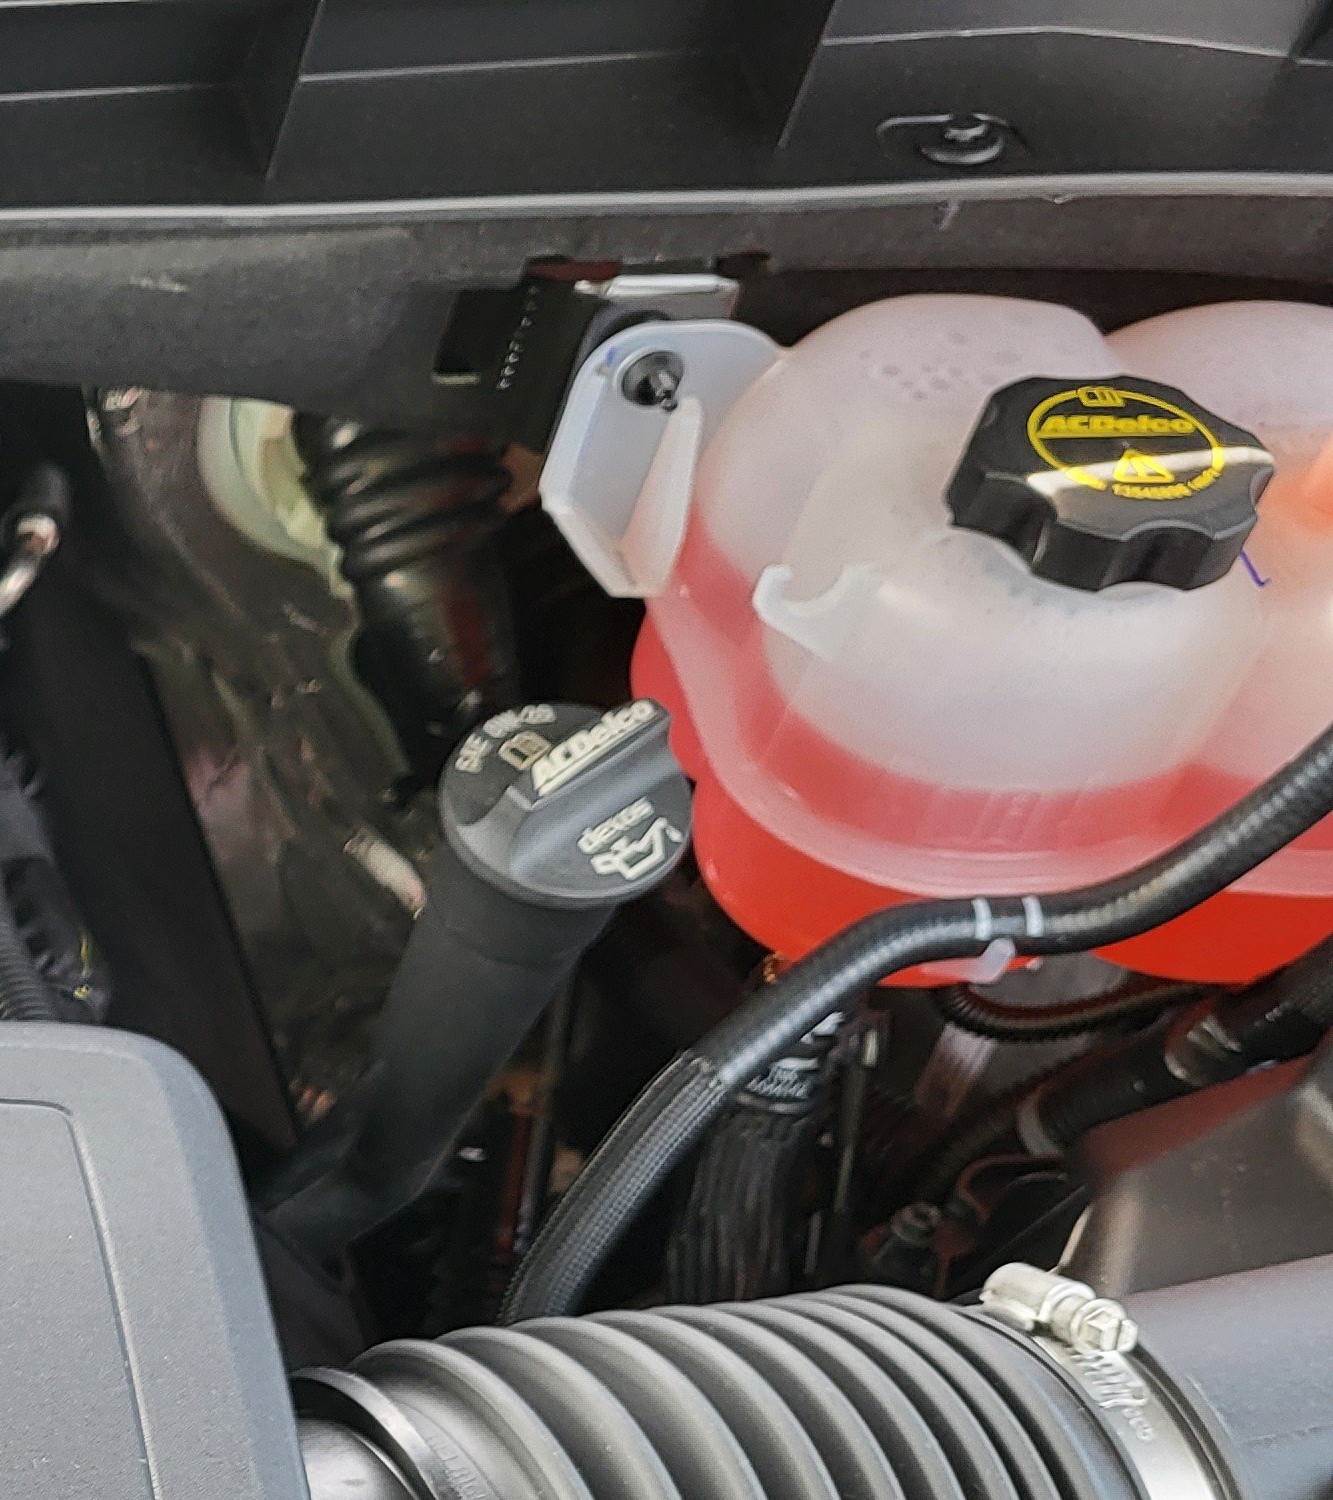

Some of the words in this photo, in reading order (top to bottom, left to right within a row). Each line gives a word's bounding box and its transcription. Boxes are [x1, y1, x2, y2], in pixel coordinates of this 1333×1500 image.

[1038, 414, 1196, 436] ACDelco
[455, 733, 491, 773] SAE
[532, 700, 656, 791] ACDelco
